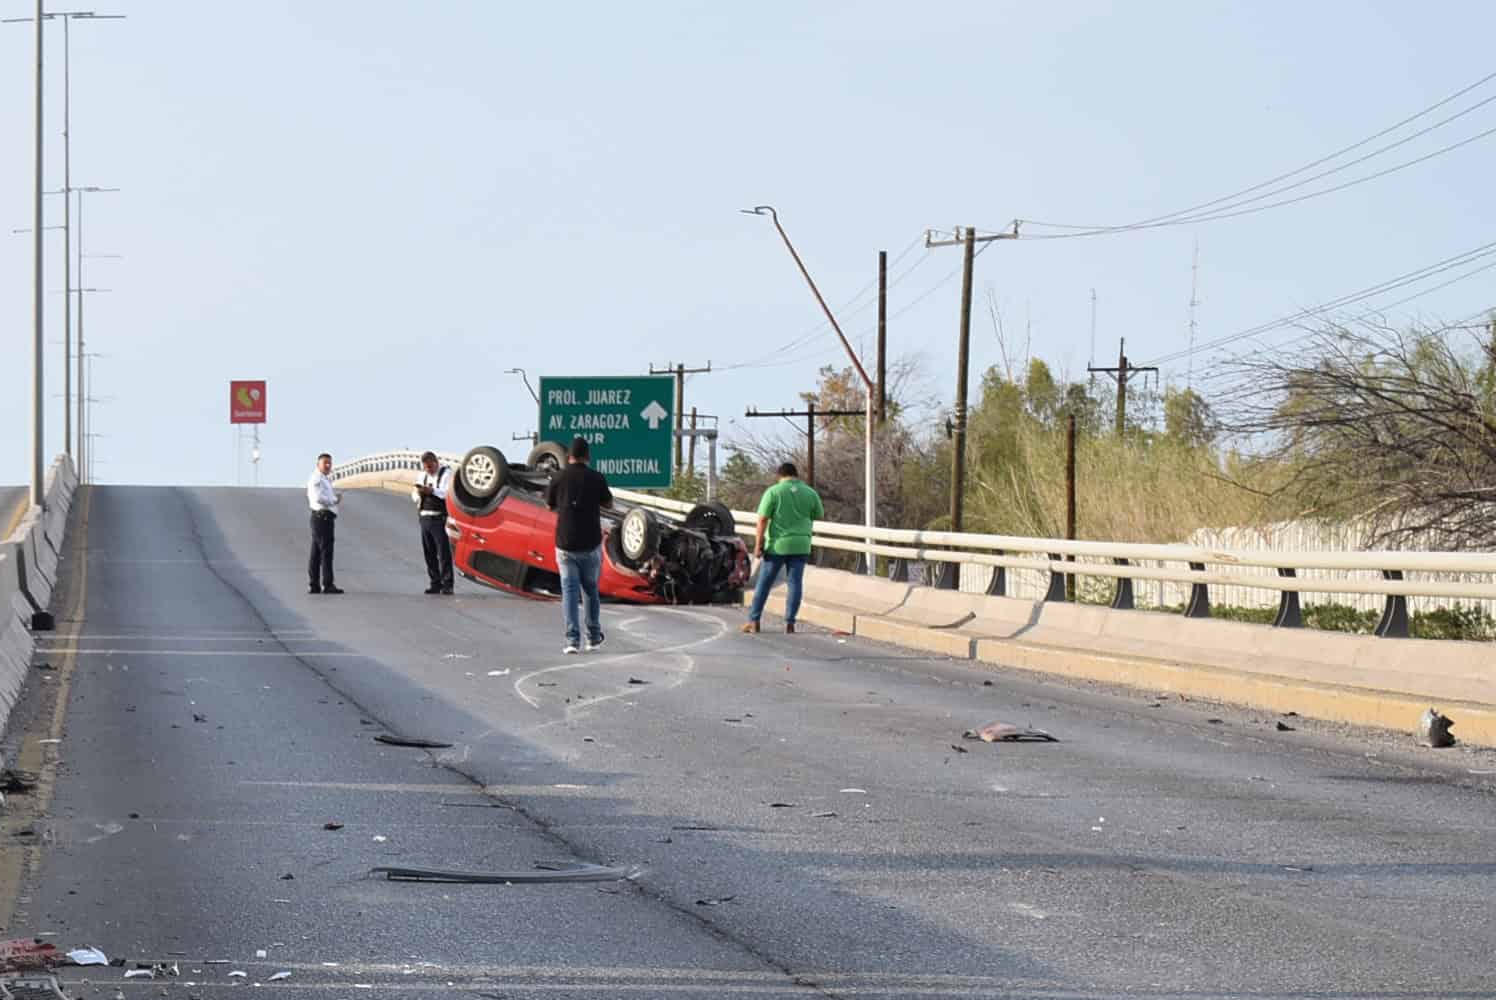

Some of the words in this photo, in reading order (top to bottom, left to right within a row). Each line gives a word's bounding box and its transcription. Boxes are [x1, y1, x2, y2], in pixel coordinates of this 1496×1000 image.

[548, 390, 581, 405] PROL.
[585, 390, 632, 405] JUAREZ
[549, 415, 566, 430] AV.
[570, 414, 630, 430] ZARAGOZA
[596, 459, 661, 474] INDUSTRIAL
